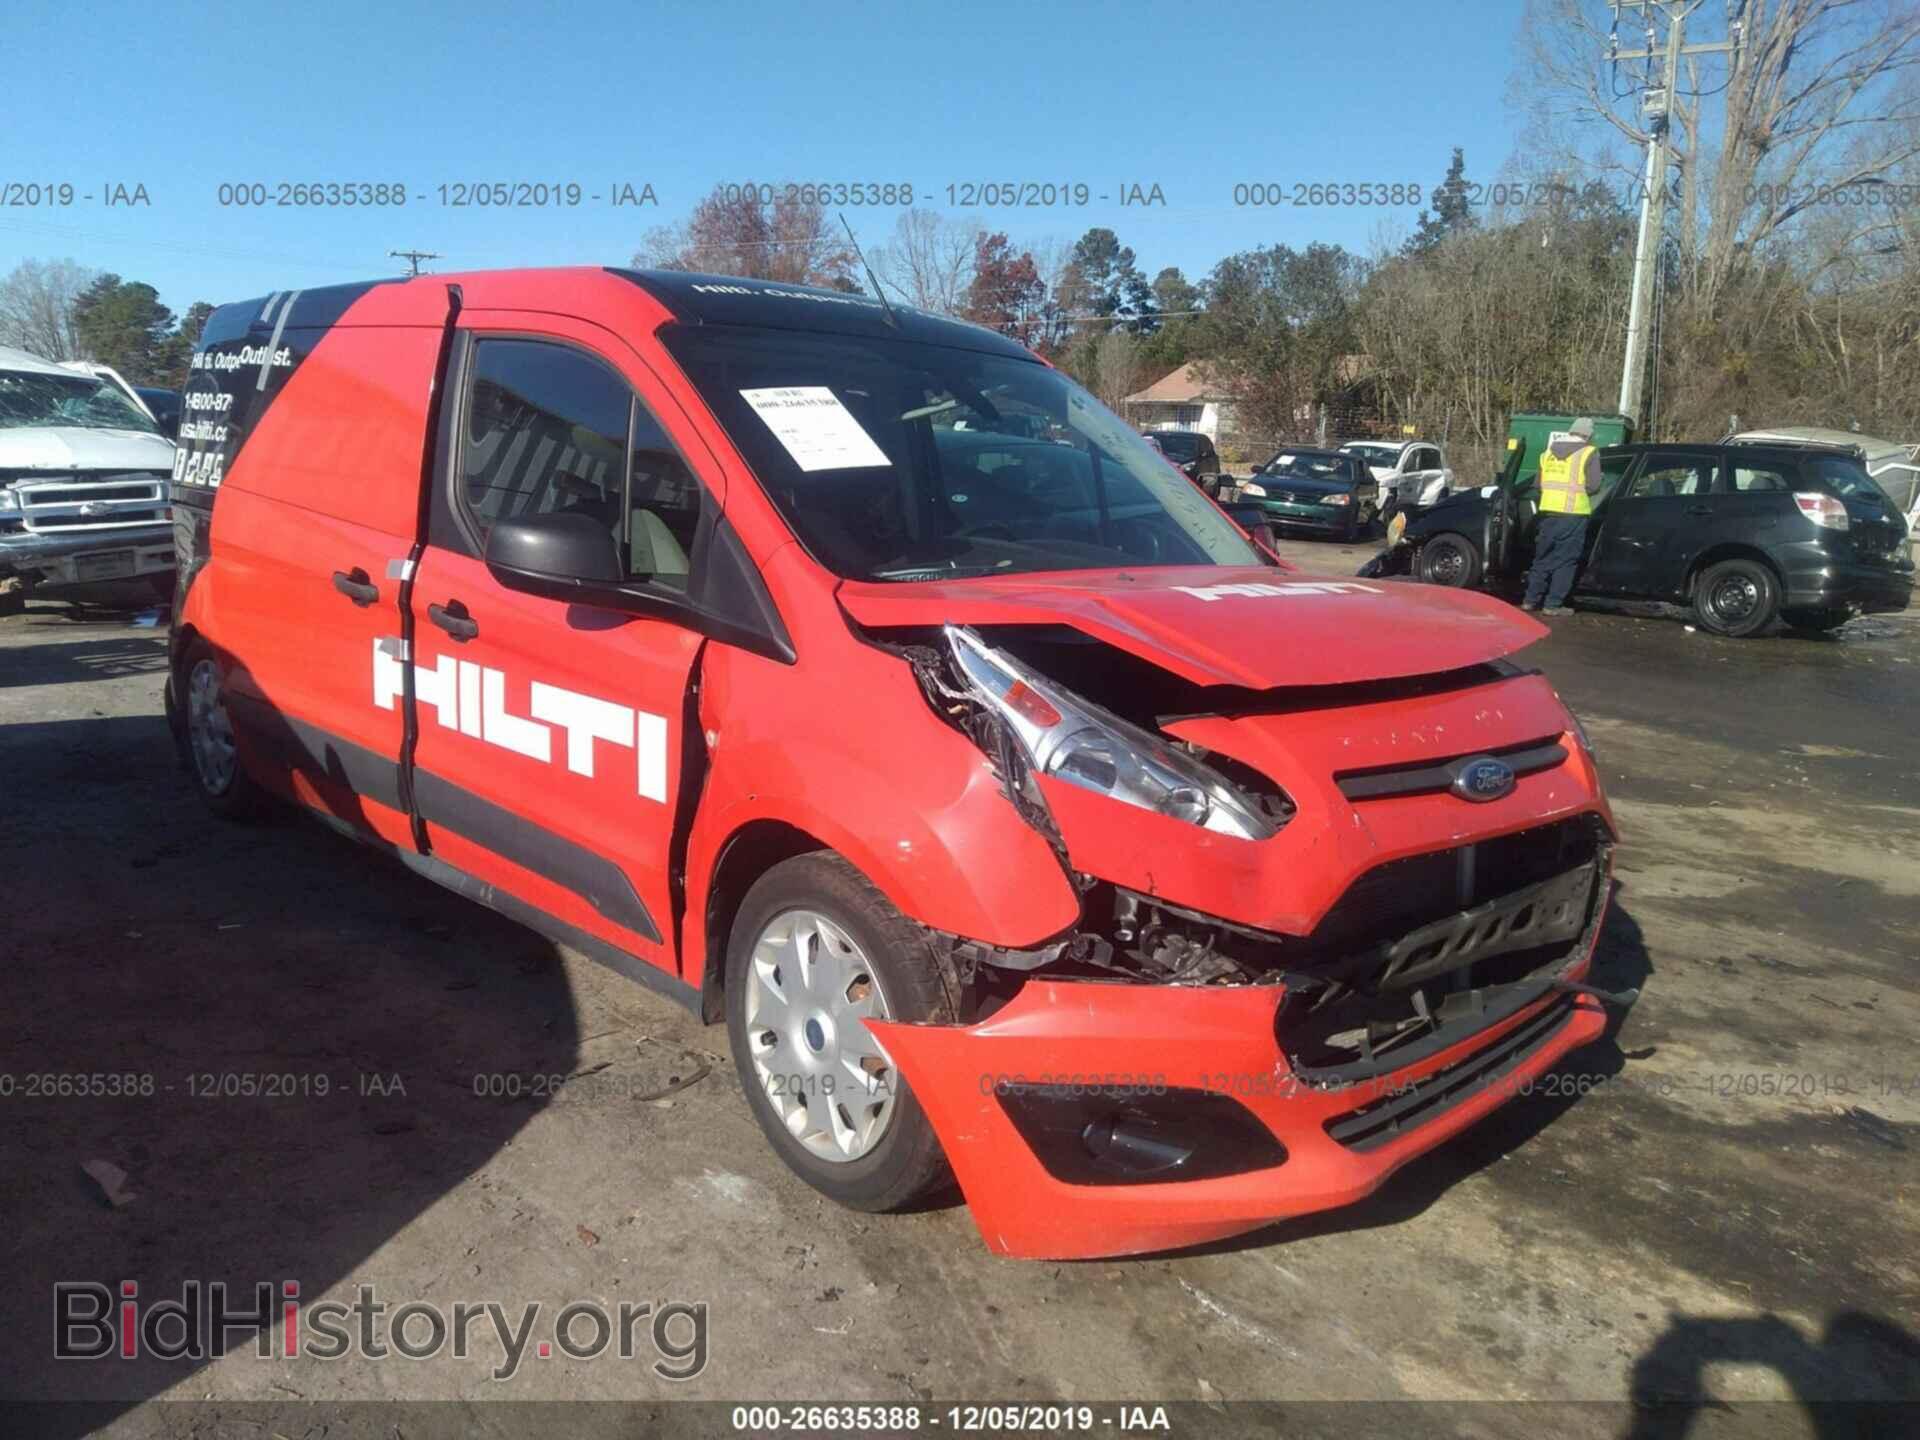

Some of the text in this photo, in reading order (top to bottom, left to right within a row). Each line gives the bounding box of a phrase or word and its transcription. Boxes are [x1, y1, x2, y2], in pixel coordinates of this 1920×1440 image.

[240, 345, 292, 367] Outlst.
[1169, 582, 1385, 602] HILTI
[373, 638, 667, 804] HILTI
